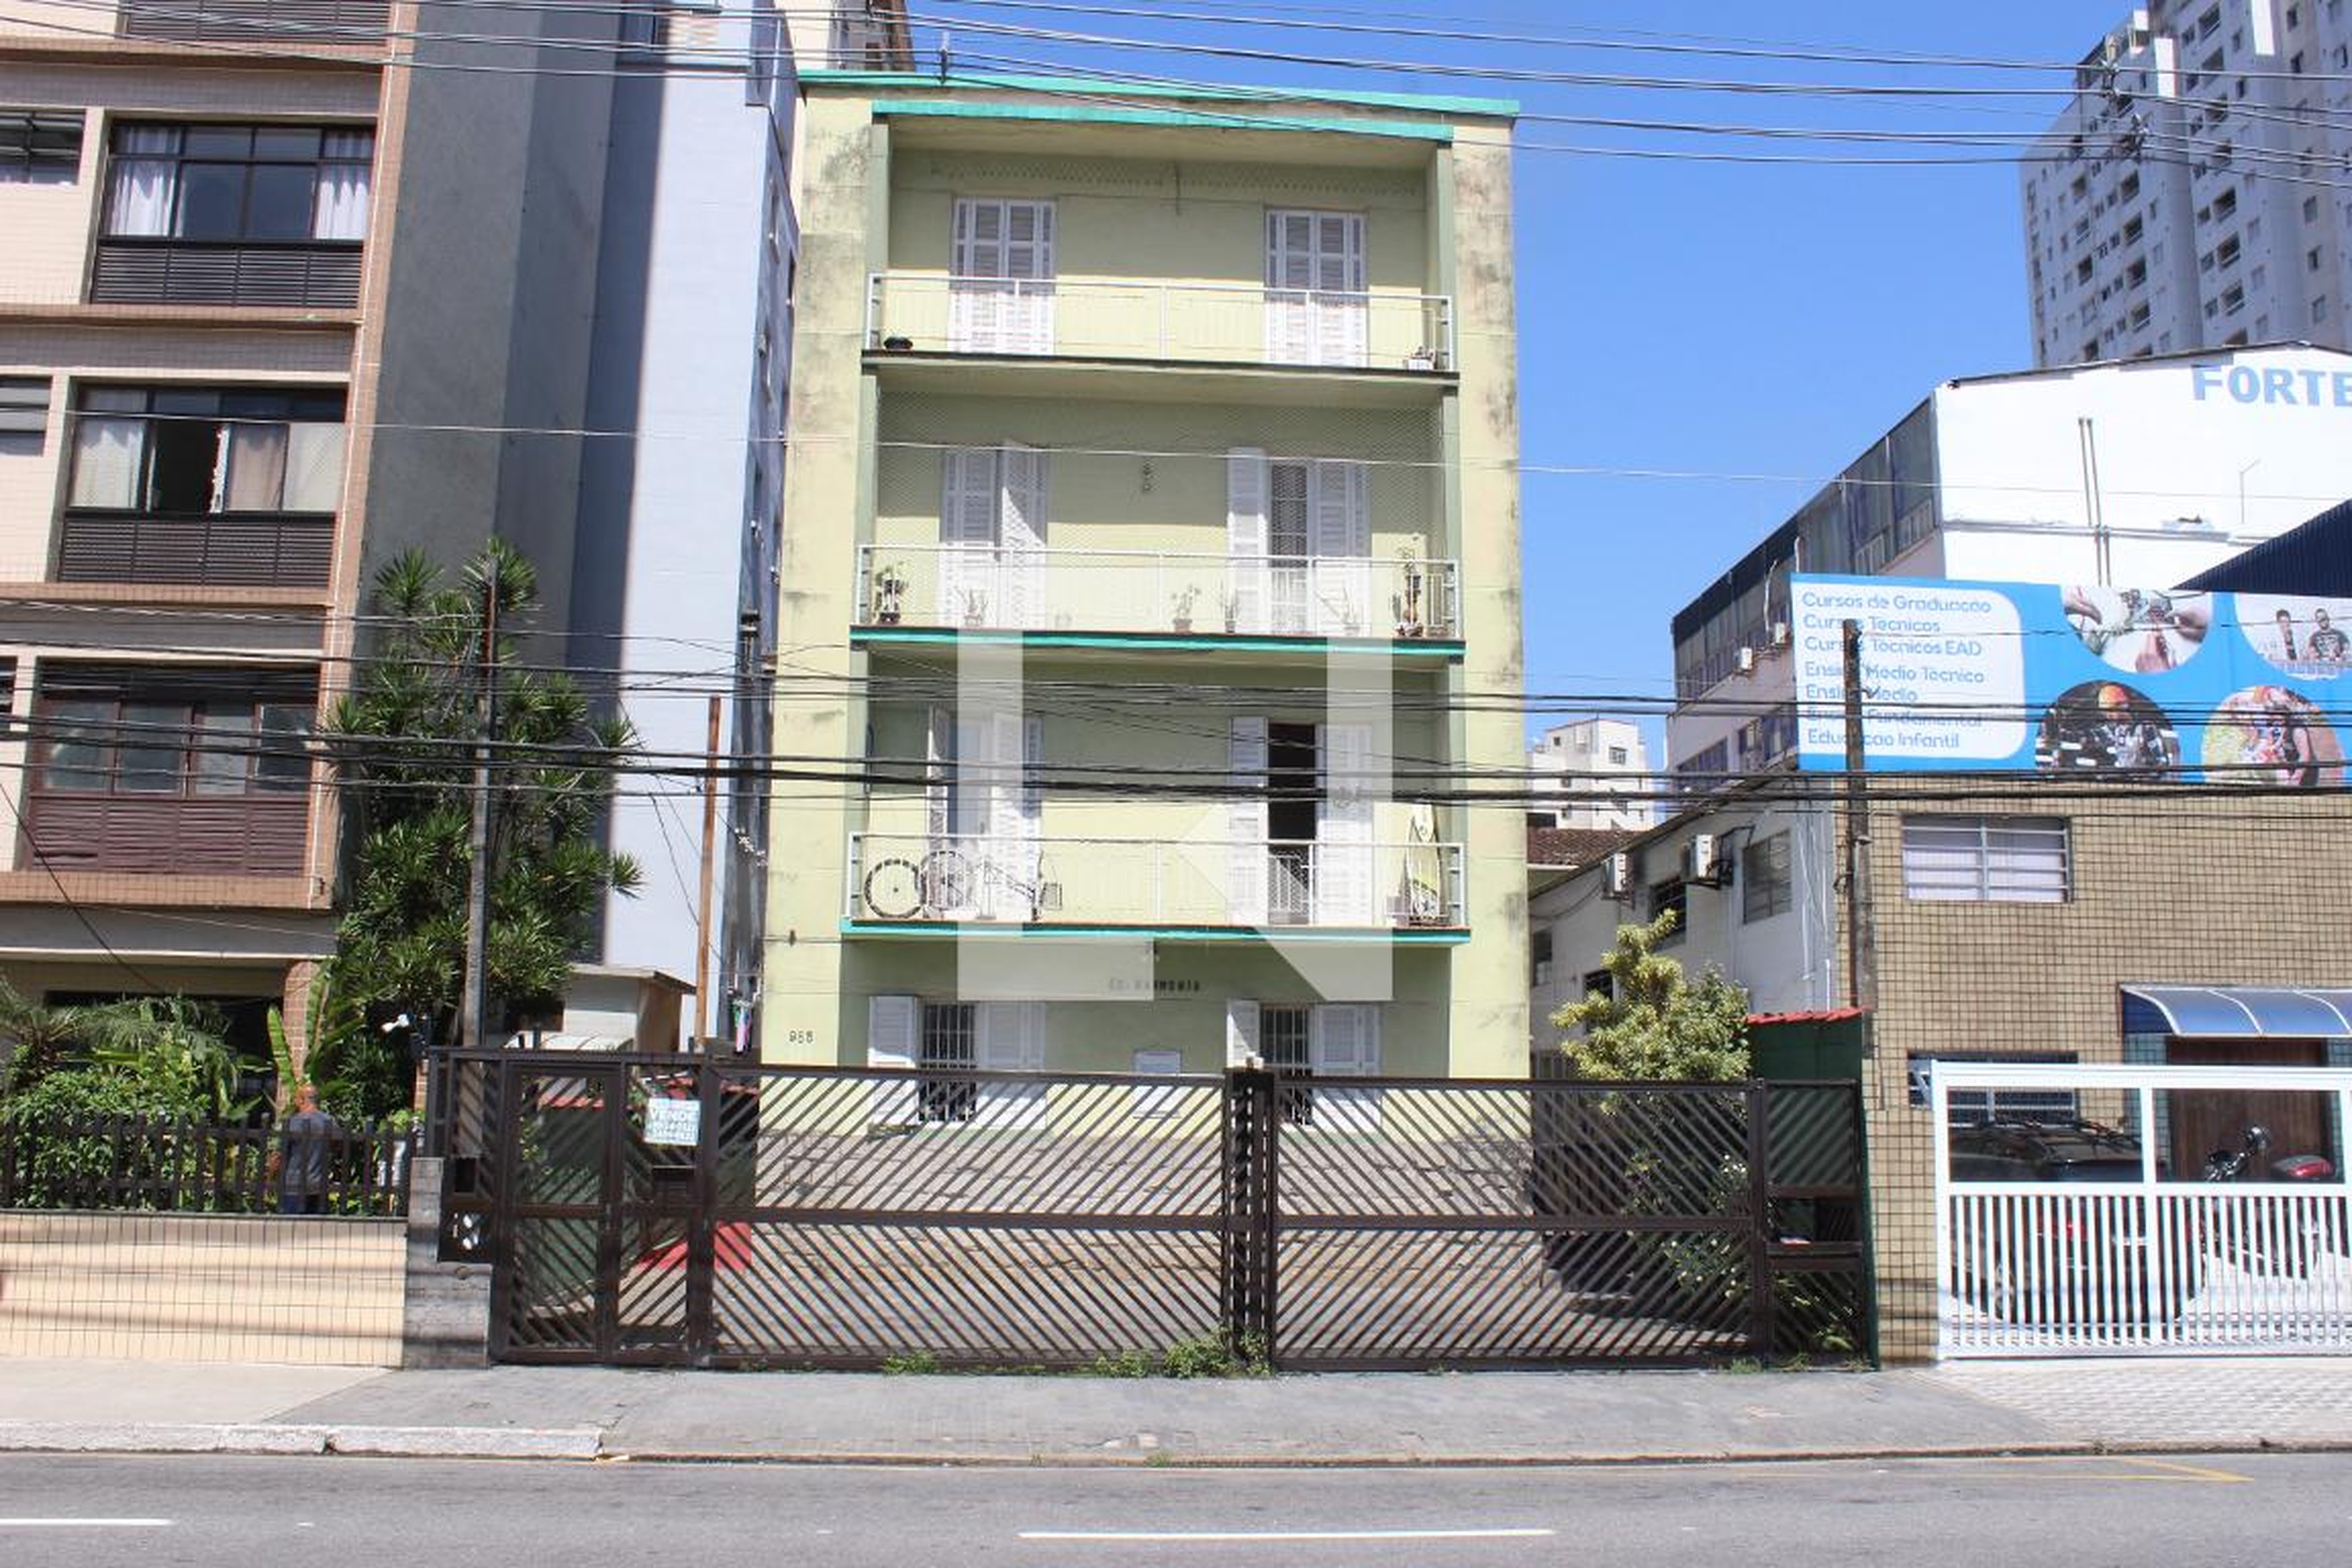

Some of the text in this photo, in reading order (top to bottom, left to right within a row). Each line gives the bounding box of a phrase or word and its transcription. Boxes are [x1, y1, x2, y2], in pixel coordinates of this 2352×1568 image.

[1802, 591, 1863, 608] Cursos
[1867, 594, 1890, 609] de
[1803, 613, 1864, 629] Curss
[1805, 635, 1864, 652] Curss
[1945, 640, 1983, 656] EAD
[1898, 733, 1960, 748] Infantil
